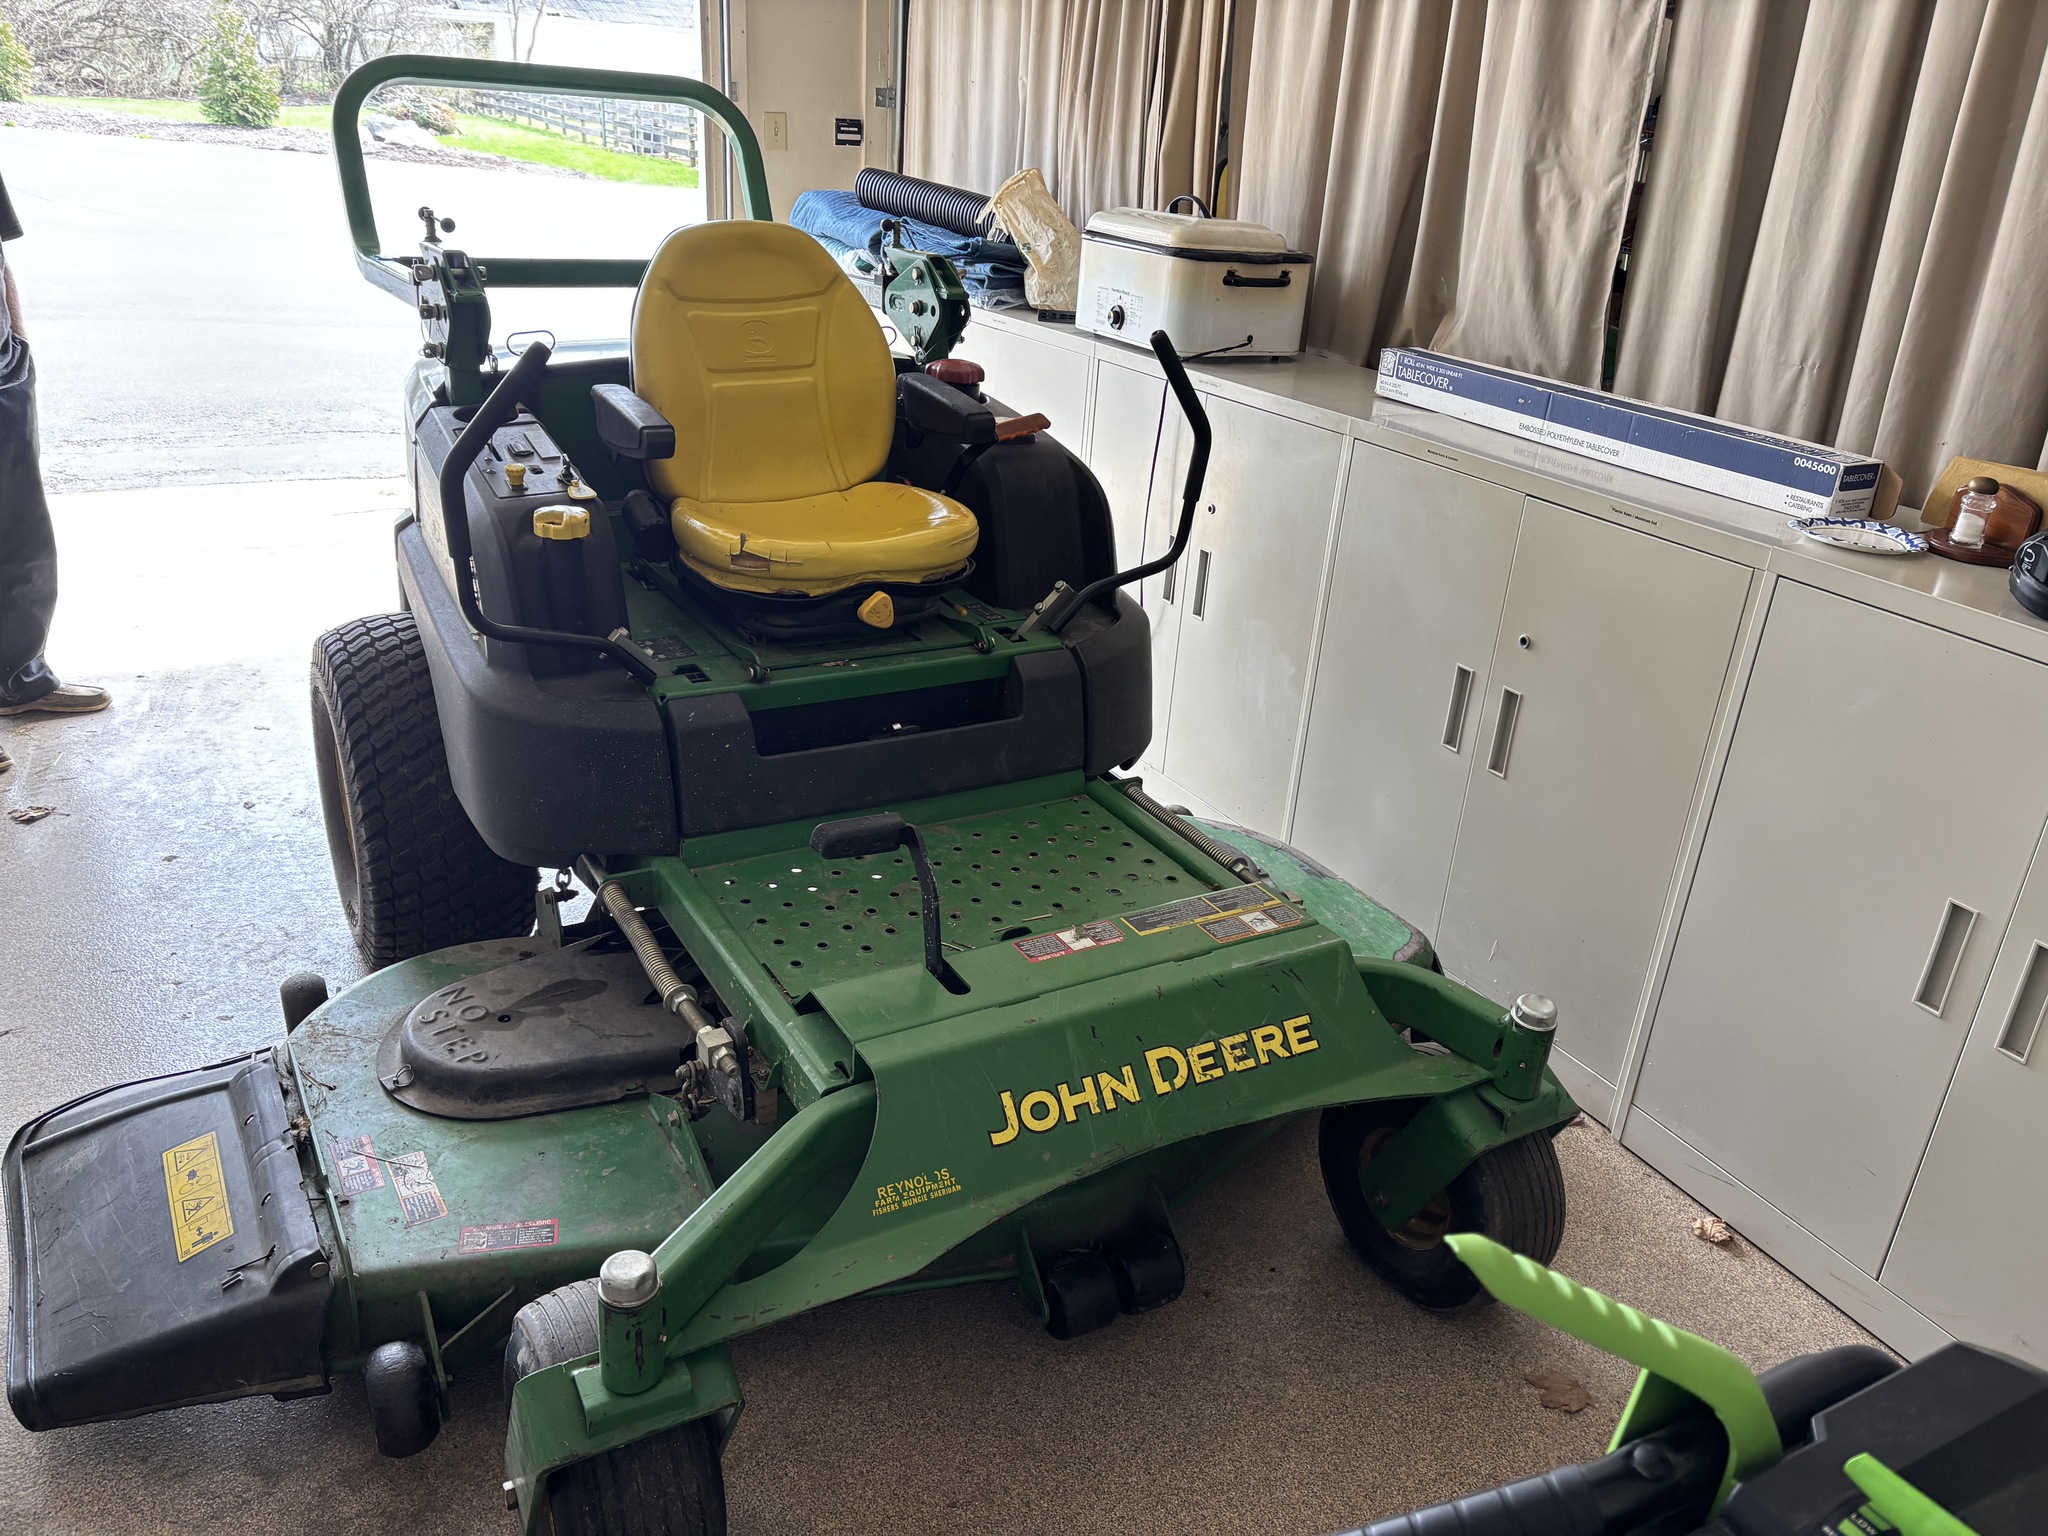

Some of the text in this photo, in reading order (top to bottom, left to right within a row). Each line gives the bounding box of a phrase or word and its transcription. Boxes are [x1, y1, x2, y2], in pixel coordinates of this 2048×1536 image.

[1404, 357, 1416, 367] ROLL
[1519, 422, 1621, 458] EMBOSSED POLYETHYLENE TABLECOVER
[1794, 457, 1837, 475] 0045600
[1787, 502, 1813, 513] CATERING
[1789, 494, 1824, 509] RESTAURANTS
[437, 986, 489, 1022] NO
[419, 1009, 489, 1063] STEP
[988, 1014, 1320, 1147] JOHN DEERE
[903, 1177, 956, 1199] EQUIPMENT
[872, 1184, 962, 1216] FISHERS MUNCIE SHERIDAN
[1850, 1512, 1878, 1535] LOW
